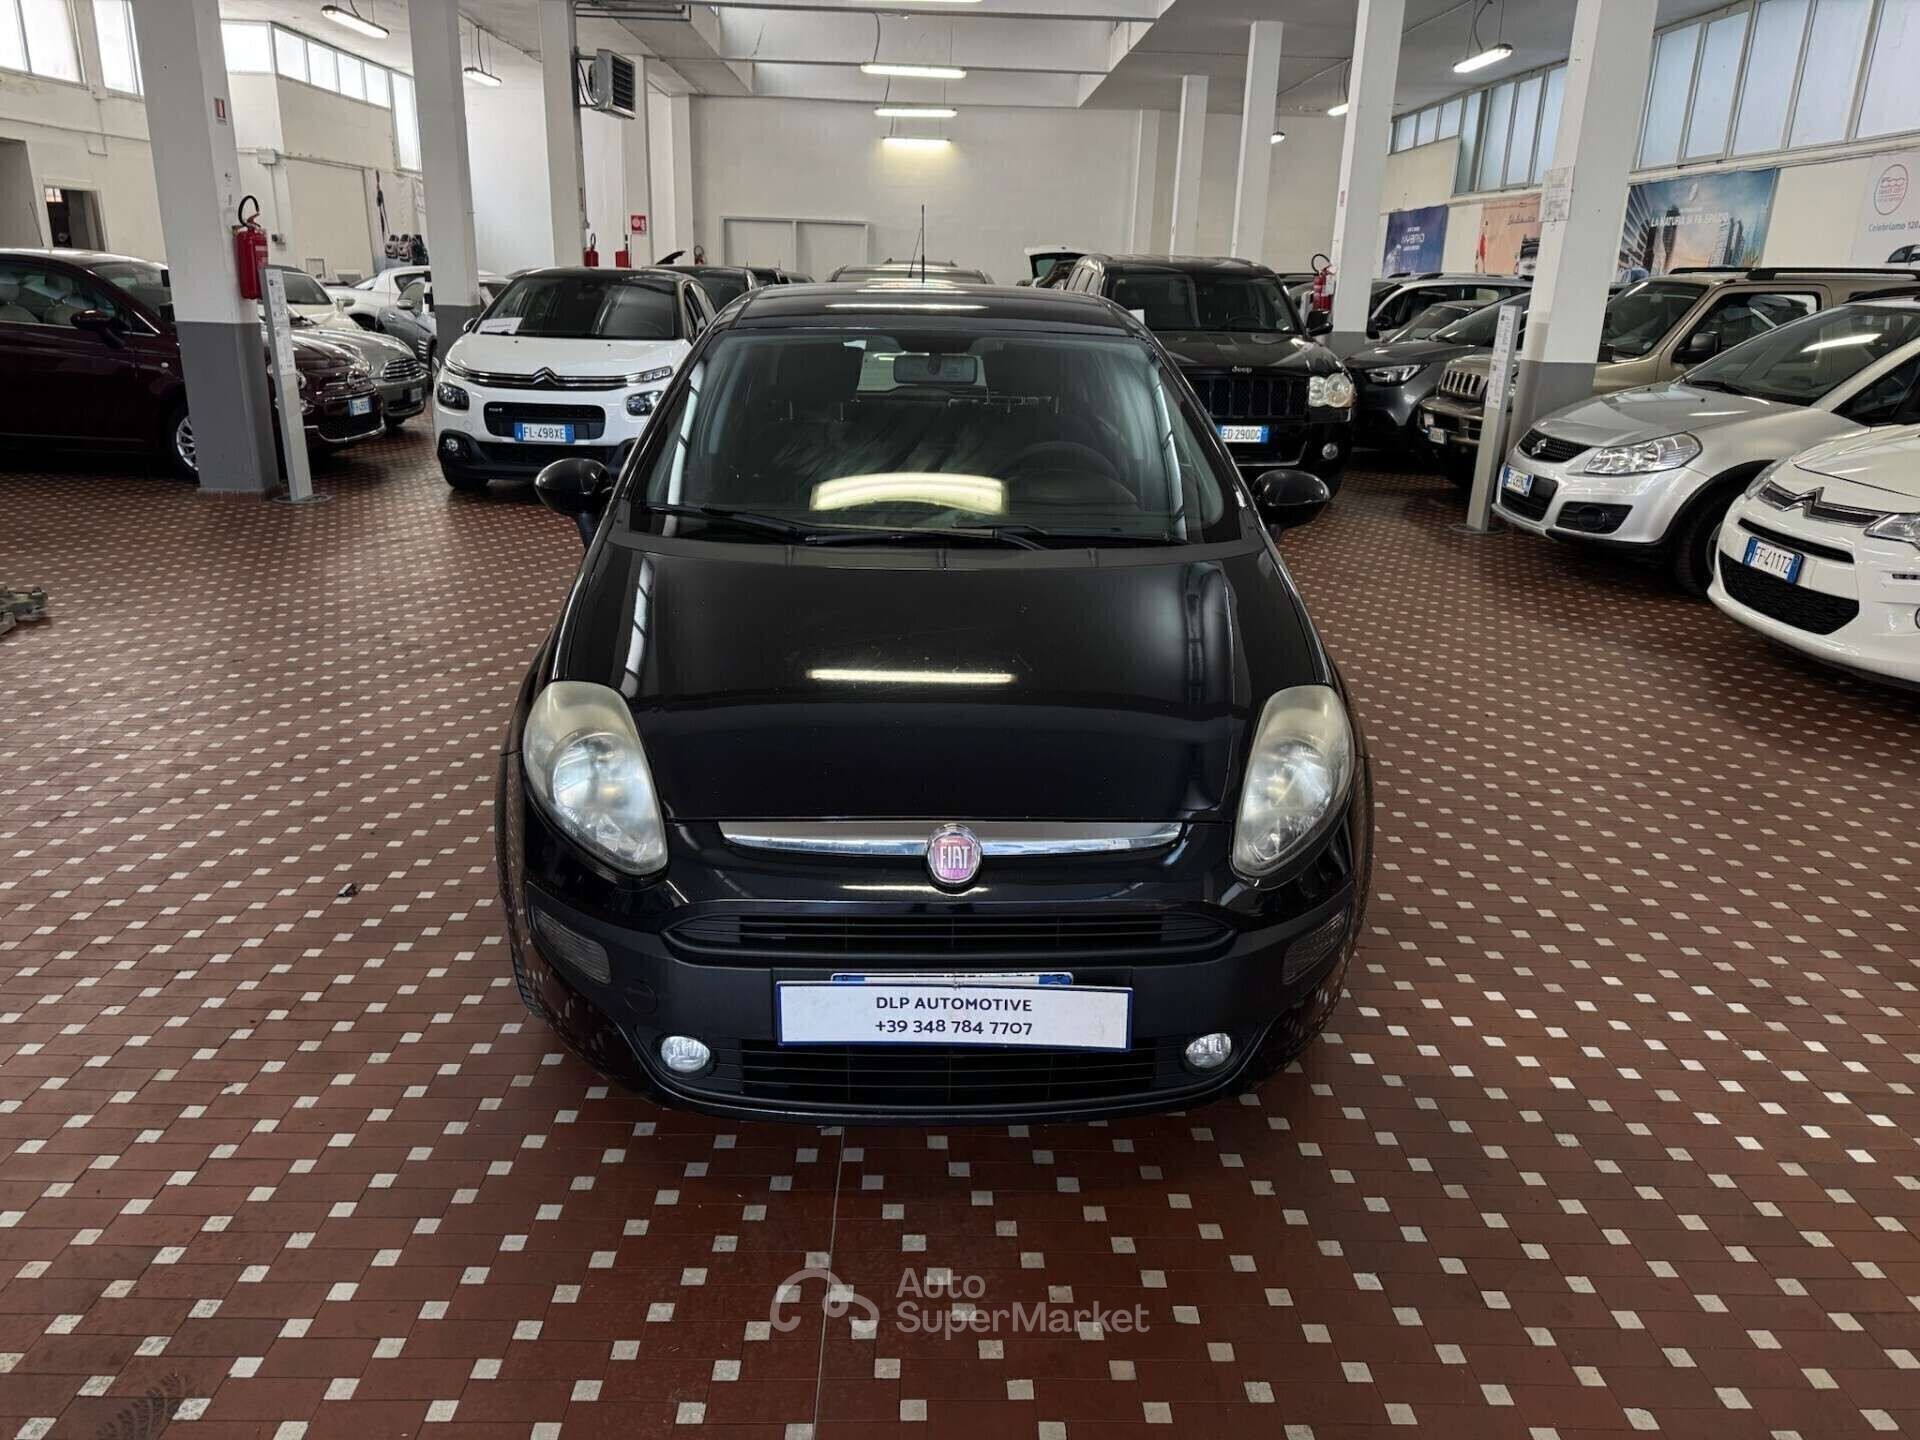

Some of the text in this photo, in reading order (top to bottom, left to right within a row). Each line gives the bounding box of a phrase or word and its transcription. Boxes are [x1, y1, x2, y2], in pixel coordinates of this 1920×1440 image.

[1232, 365, 1253, 374] Jeep
[940, 845, 971, 869] FIAT
[876, 996, 1033, 1012] DLP AUTOMOTIVE
[875, 1019, 1033, 1036] +39 348 784 7707
